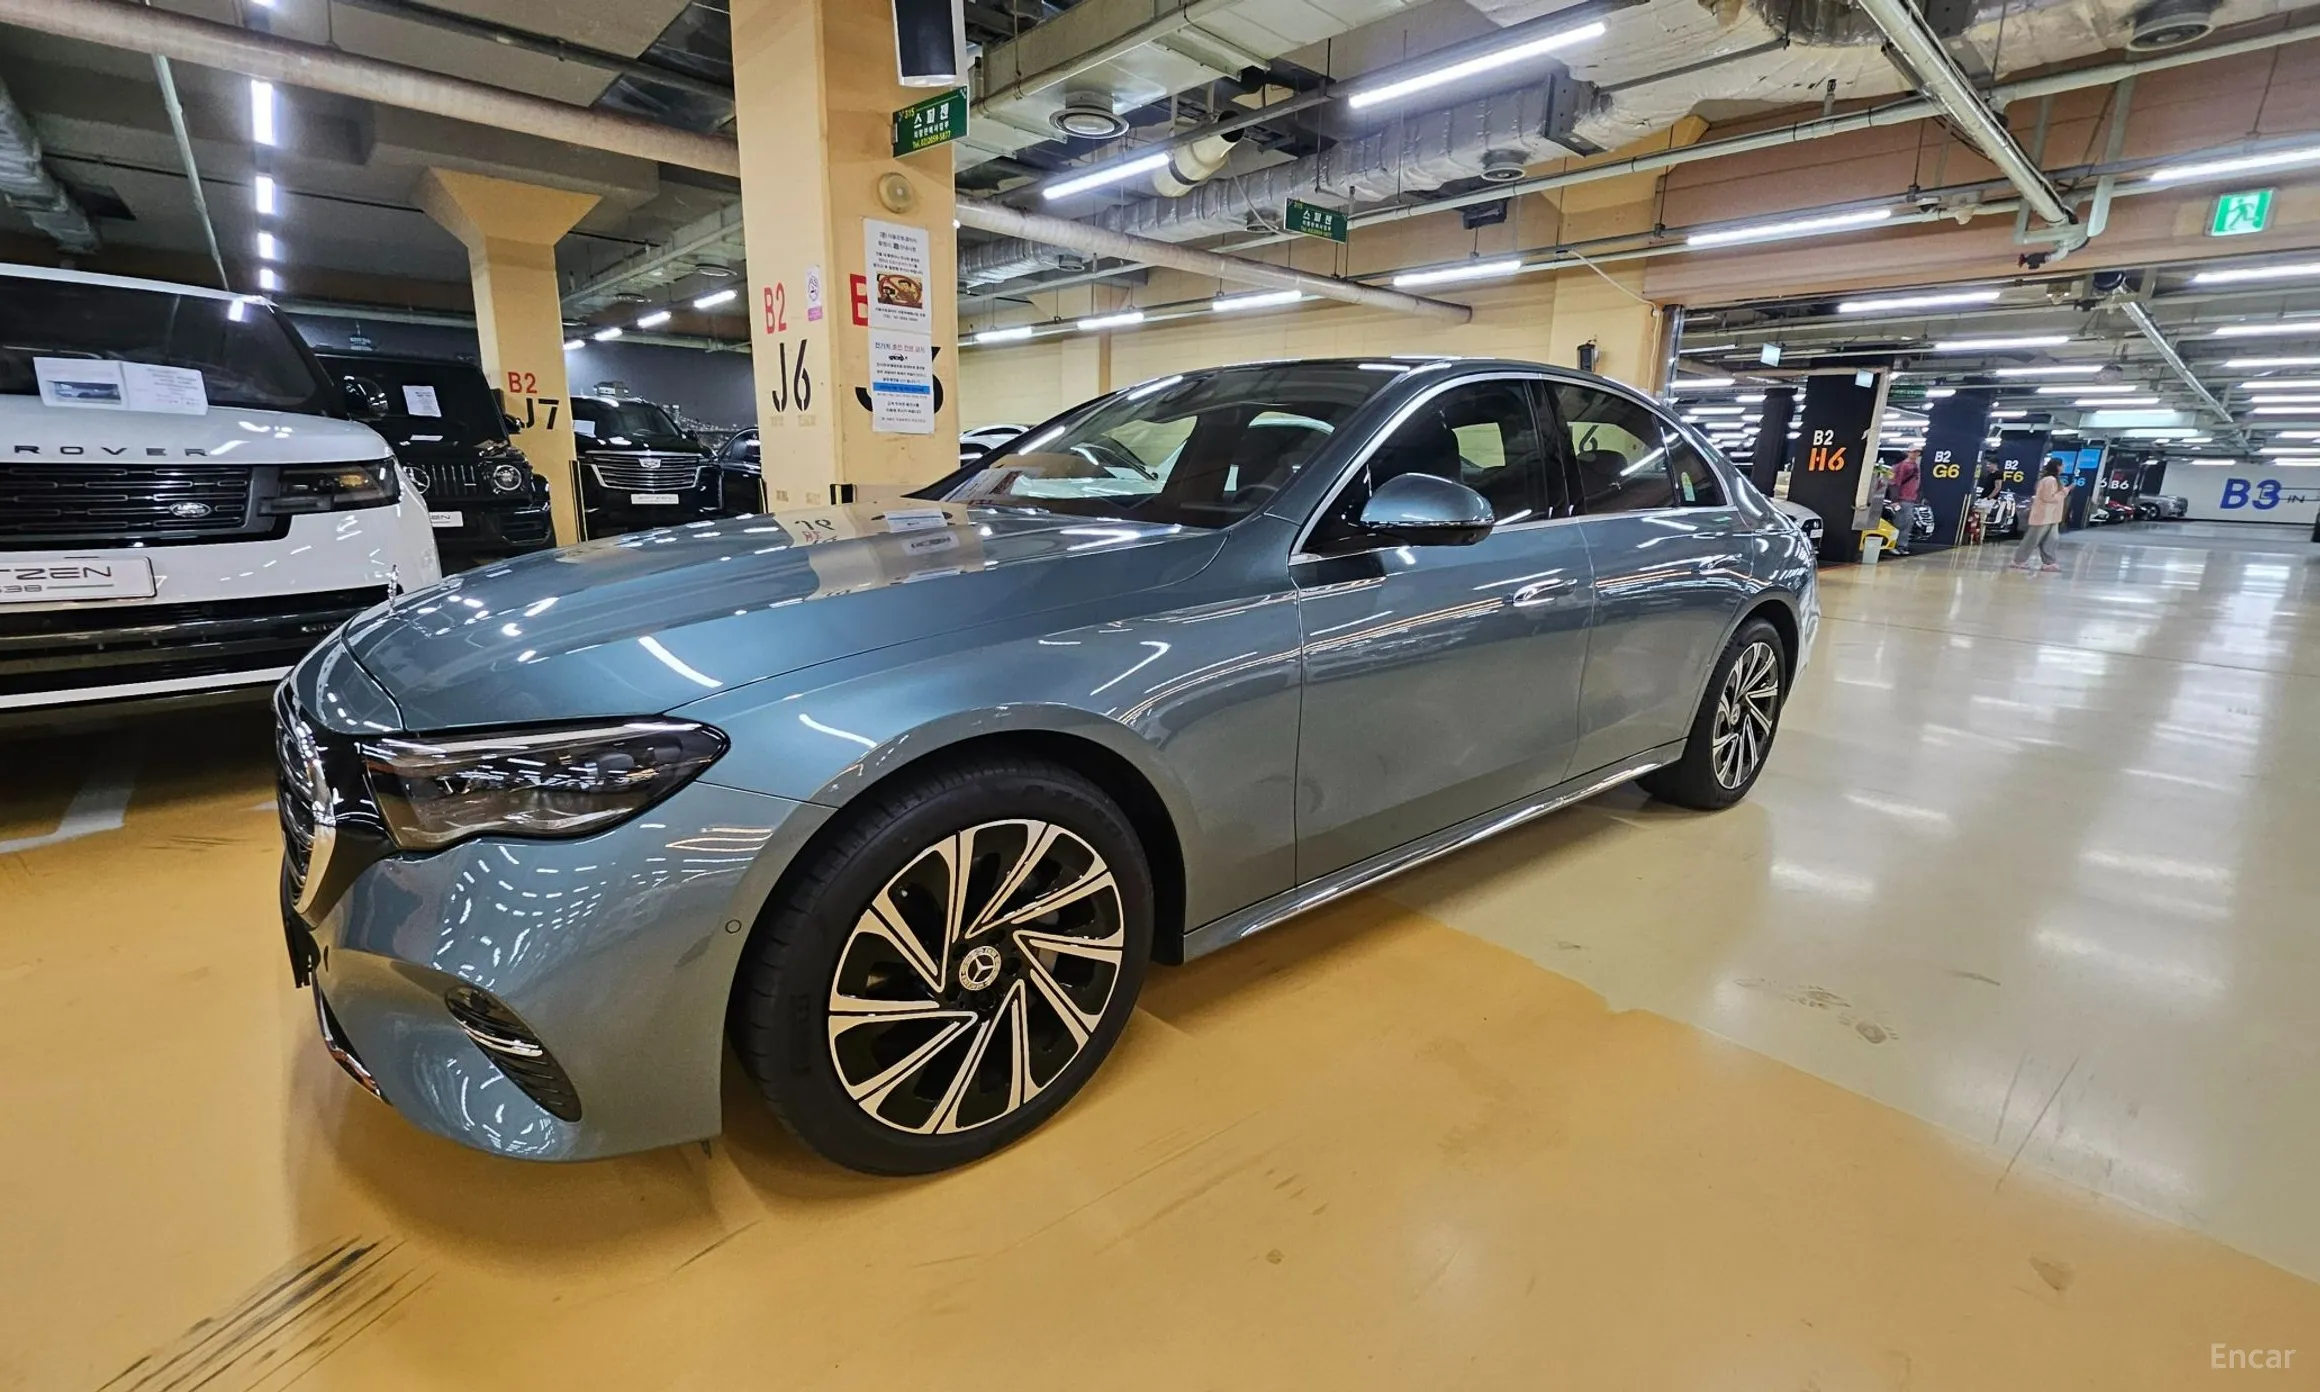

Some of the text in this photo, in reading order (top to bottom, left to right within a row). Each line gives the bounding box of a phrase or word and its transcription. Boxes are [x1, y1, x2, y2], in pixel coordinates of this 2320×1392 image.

[764, 283, 787, 334] B2
[508, 371, 537, 394] B2
[772, 339, 811, 412] J6
[525, 397, 560, 430] J7
[1813, 430, 1834, 446] B2
[14, 444, 208, 457] ROVER
[1934, 450, 1951, 462] B2
[1808, 447, 1847, 471] H6
[2005, 460, 2018, 470] B2
[1932, 464, 1960, 478] G6
[2002, 471, 2024, 483] F6
[2110, 480, 2129, 489] B6
[2219, 478, 2305, 510] B3 IN
[0, 585, 42, 594] 38
